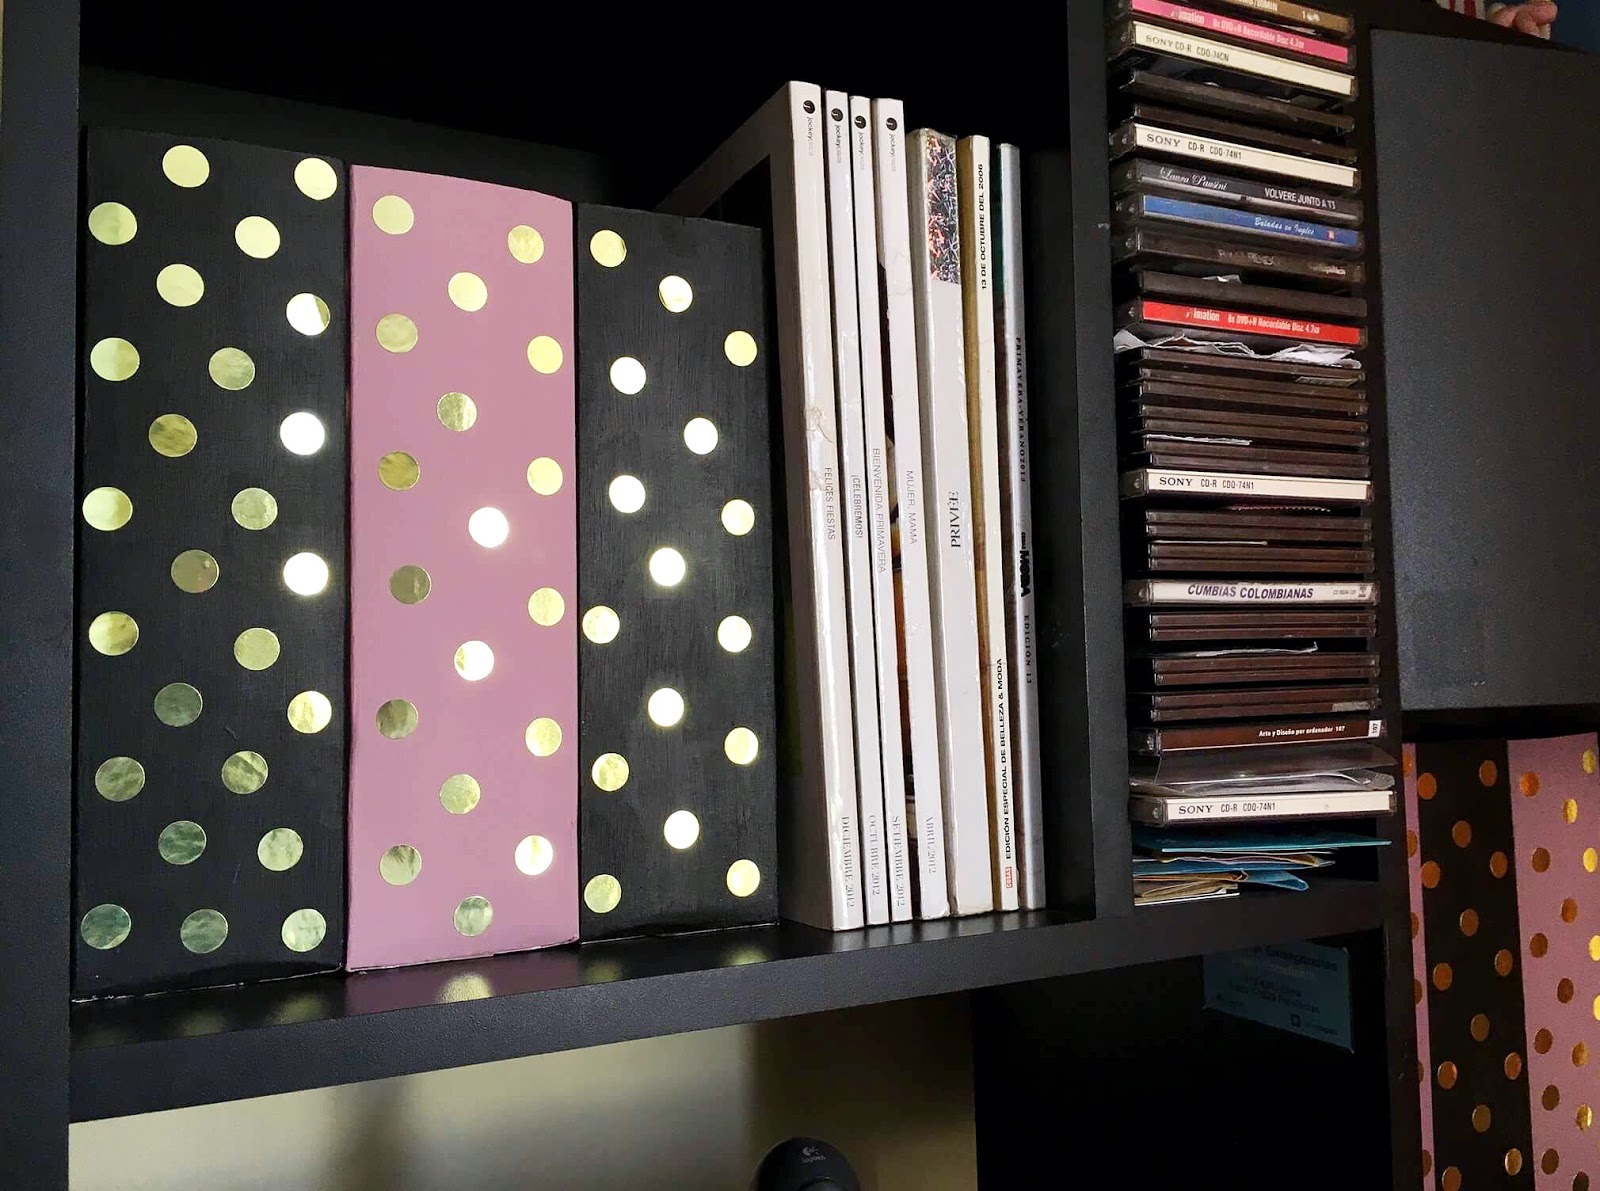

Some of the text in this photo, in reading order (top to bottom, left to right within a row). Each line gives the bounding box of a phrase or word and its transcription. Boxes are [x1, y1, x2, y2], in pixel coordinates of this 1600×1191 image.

[1146, 35, 1174, 47] SONY
[1146, 133, 1181, 147] SONY
[1188, 141, 1204, 152] CD-R
[1160, 167, 1228, 191] Laura Pausini
[1264, 187, 1296, 202] VOLVERE
[1297, 194, 1320, 207] JUNTO
[1254, 217, 1282, 229] Baladas
[980, 264, 986, 277] DE
[981, 279, 987, 290] 13
[1193, 307, 1220, 321] imation
[1236, 315, 1257, 326] DVD+R
[1258, 317, 1291, 331] Recordable
[1292, 322, 1304, 332] Disc
[906, 470, 915, 509] MUJER,
[1159, 477, 1193, 486] SONY
[1200, 478, 1217, 488] CD-R
[824, 467, 836, 540] FELICES FIESTAS
[872, 448, 886, 574] BIENVENIDA PRIMAVERA
[1187, 584, 1314, 599] CUMBIAS COLOMBIANAS
[1295, 729, 1305, 737] por
[1306, 726, 1333, 735] ordenador
[1000, 749, 1006, 763] DE
[1001, 766, 1009, 815] ESPECIAL
[1178, 805, 1213, 815] SONY
[1220, 803, 1238, 813] CD-R
[841, 816, 855, 908] DICIEMBRE 2012
[868, 815, 881, 896] OCTUBRE 2012
[892, 815, 906, 907] SETIEMBRE 2012
[927, 850, 937, 874] 2012
